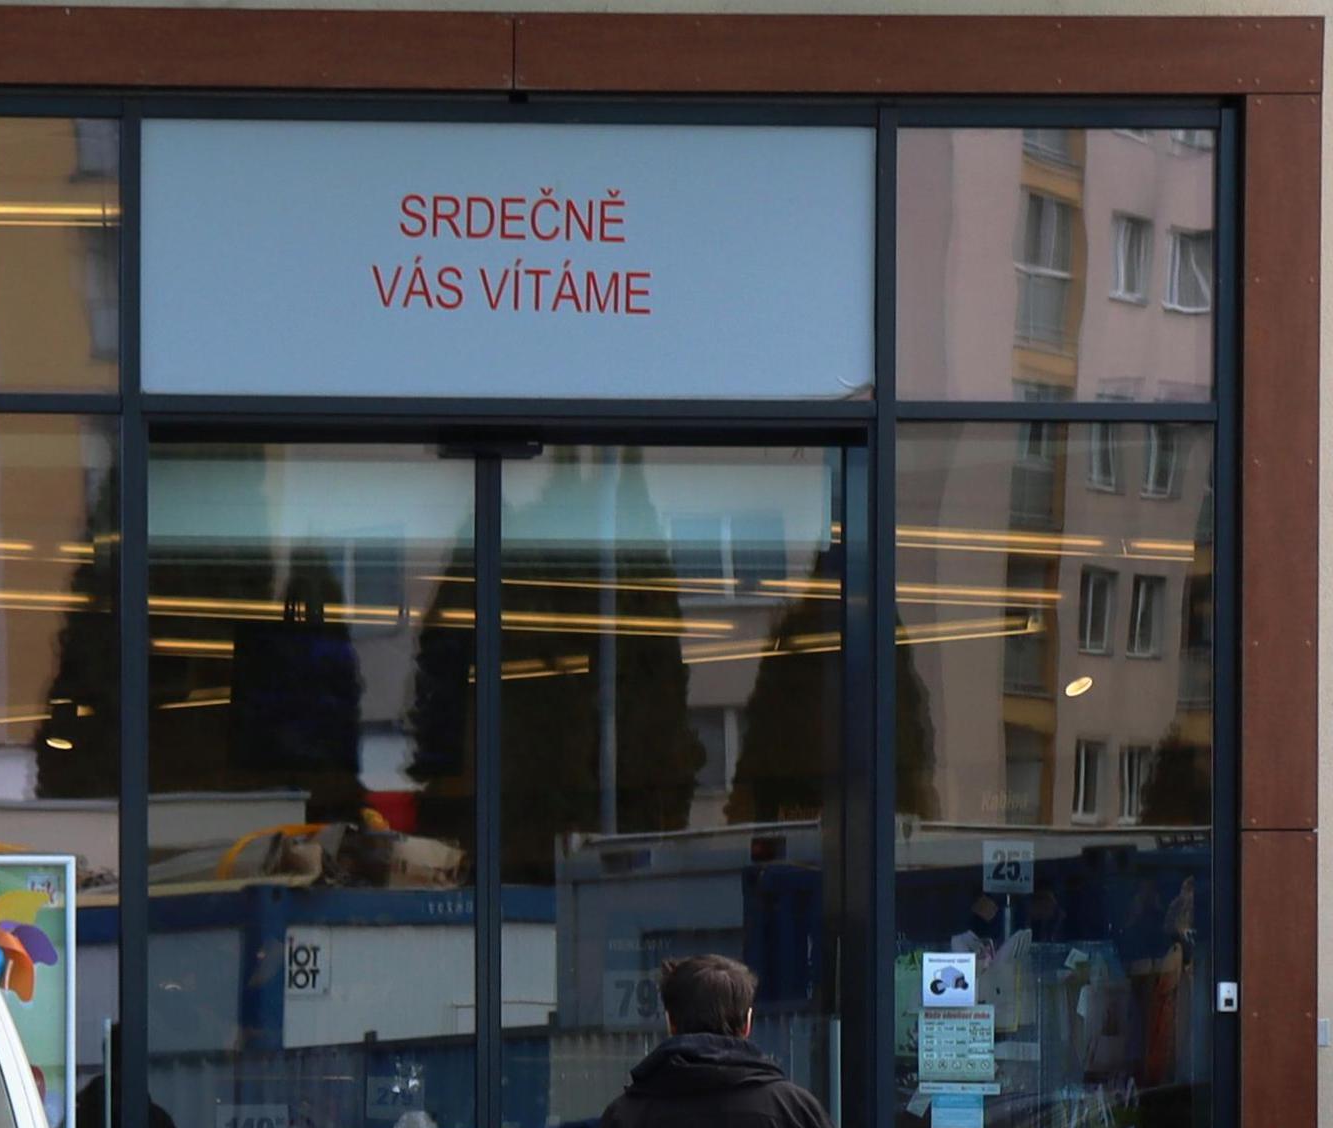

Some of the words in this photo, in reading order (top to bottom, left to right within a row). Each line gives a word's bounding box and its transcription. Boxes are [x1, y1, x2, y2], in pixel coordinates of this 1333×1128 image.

[399, 187, 626, 243] SRDEČNĚ
[372, 256, 464, 310] VÁS
[480, 259, 652, 315] VÍTÁME
